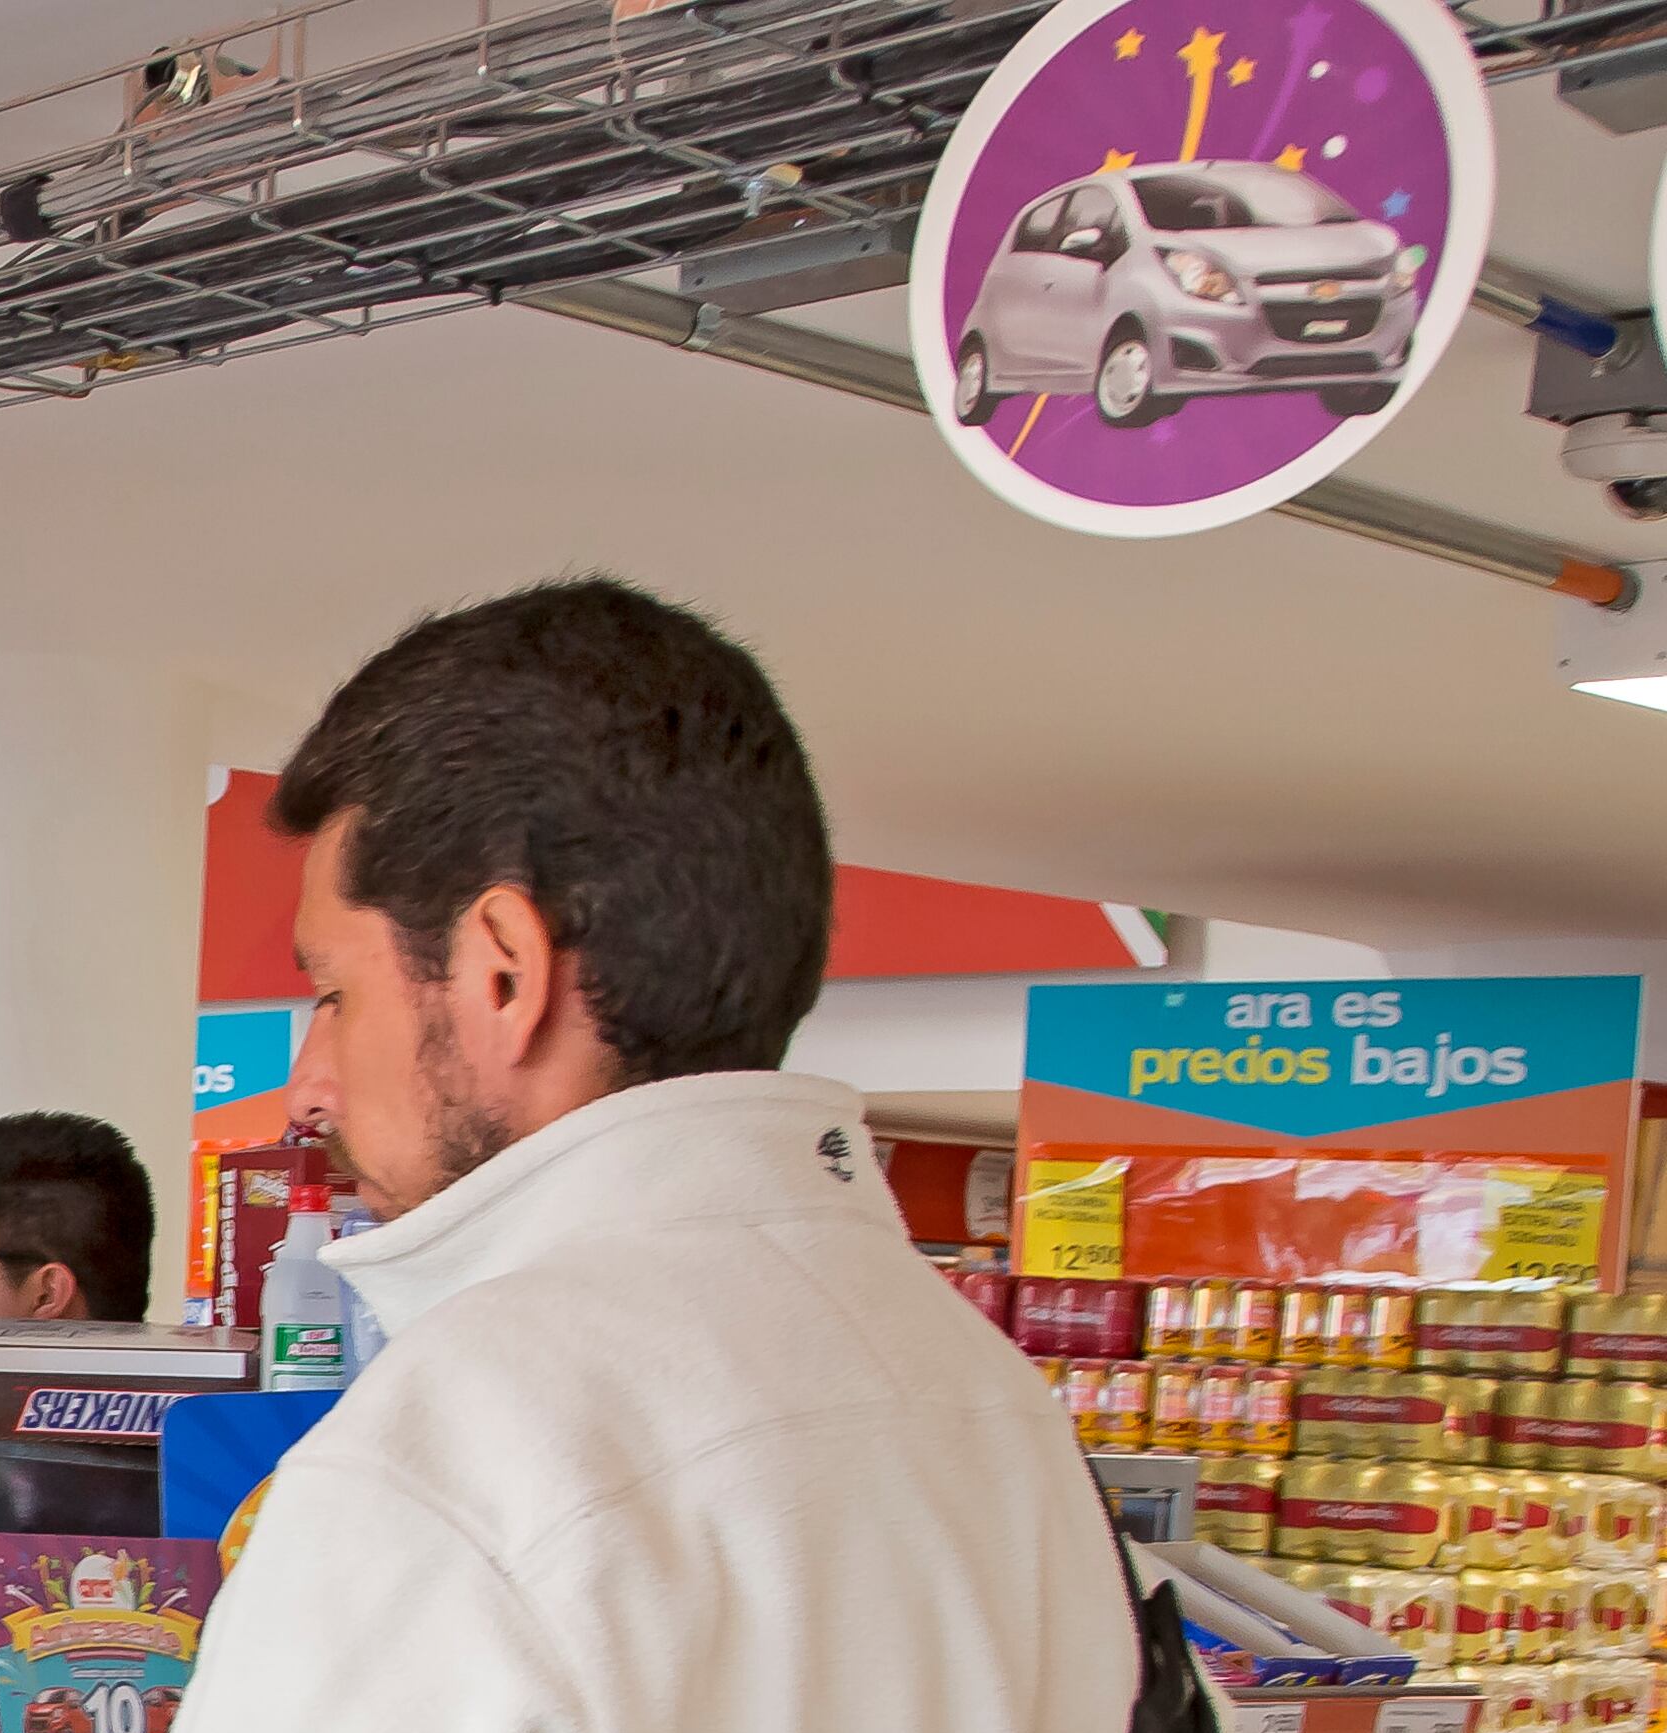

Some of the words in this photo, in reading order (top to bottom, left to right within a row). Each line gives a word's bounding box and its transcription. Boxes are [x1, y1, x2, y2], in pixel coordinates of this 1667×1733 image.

[1225, 990, 1312, 1030] ara
[1332, 988, 1403, 1028] es
[1129, 1035, 1331, 1097] precios
[1351, 1034, 1529, 1098] bajos
[22, 1390, 168, 1433] NICKERS
